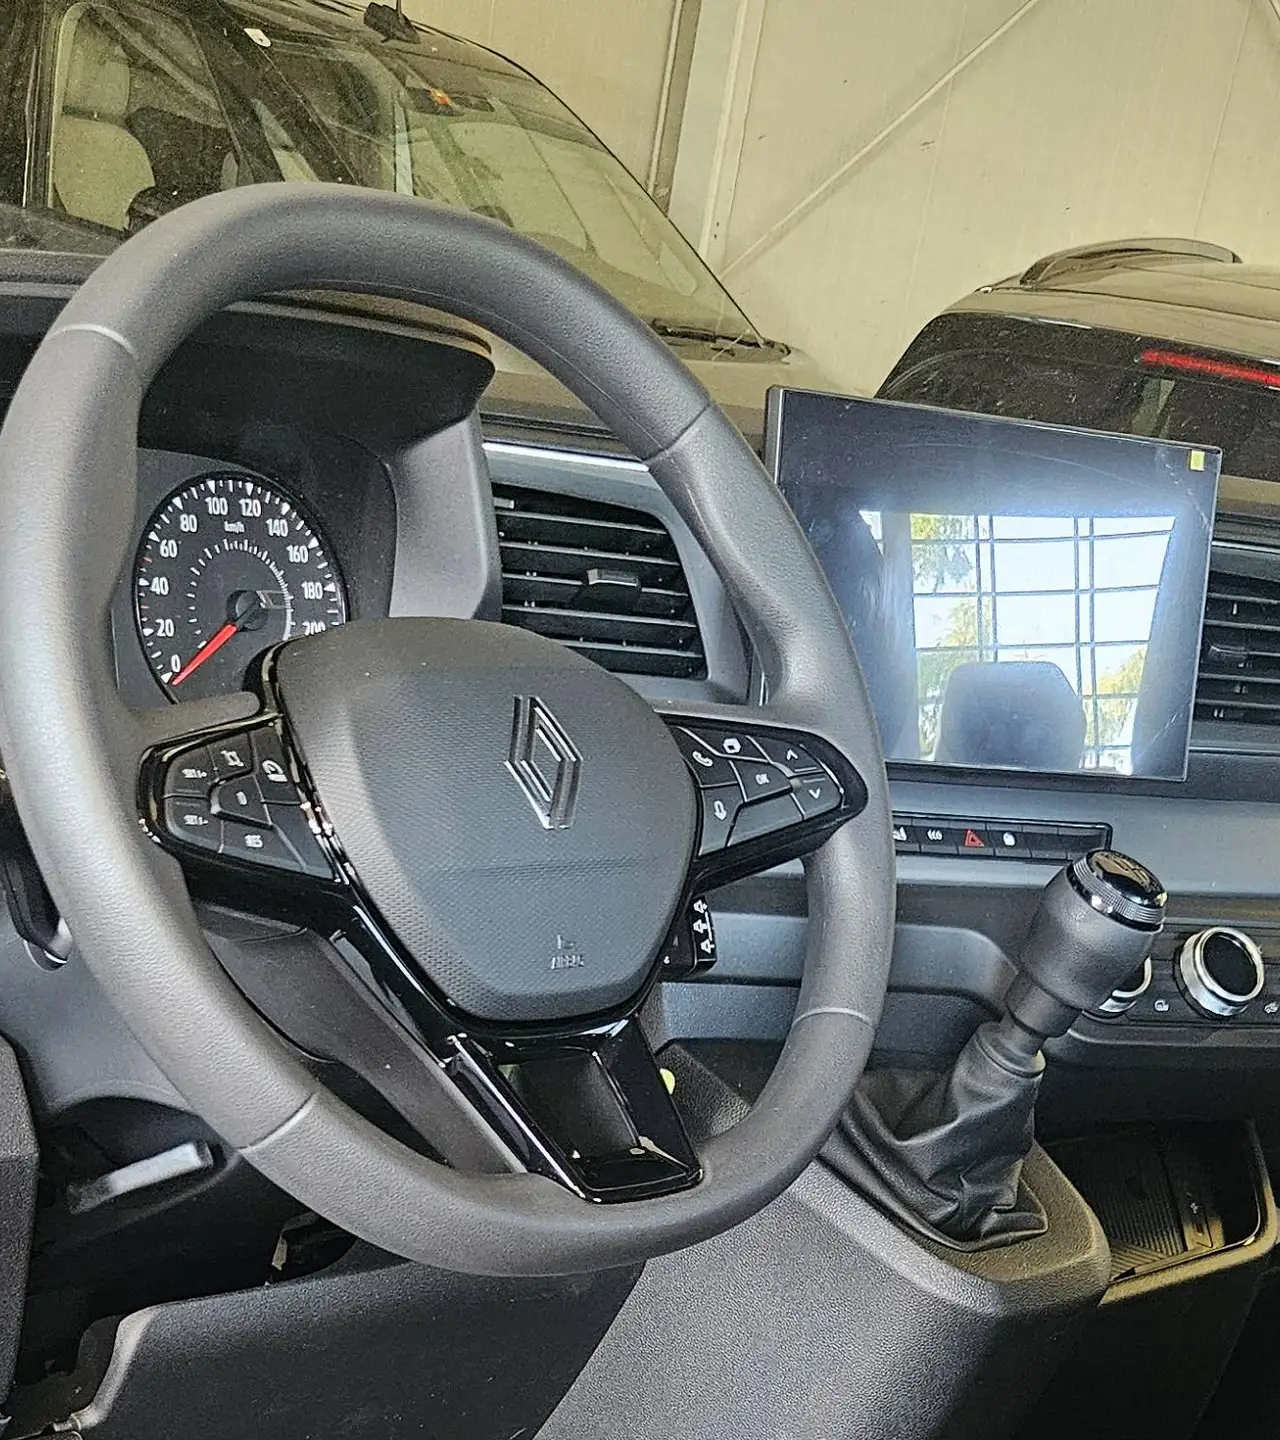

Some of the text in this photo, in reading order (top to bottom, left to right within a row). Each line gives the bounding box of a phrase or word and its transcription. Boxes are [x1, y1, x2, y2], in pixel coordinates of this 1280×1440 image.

[205, 498, 229, 516] 100
[240, 499, 262, 517] 120
[180, 515, 198, 533] 80
[224, 520, 245, 533] km/h
[266, 519, 289, 538] 140
[160, 540, 178, 559] 60
[287, 545, 309, 564] 160
[150, 578, 170, 596] 40
[301, 581, 324, 600] 180
[156, 619, 175, 638] 20
[170, 655, 181, 673] 0
